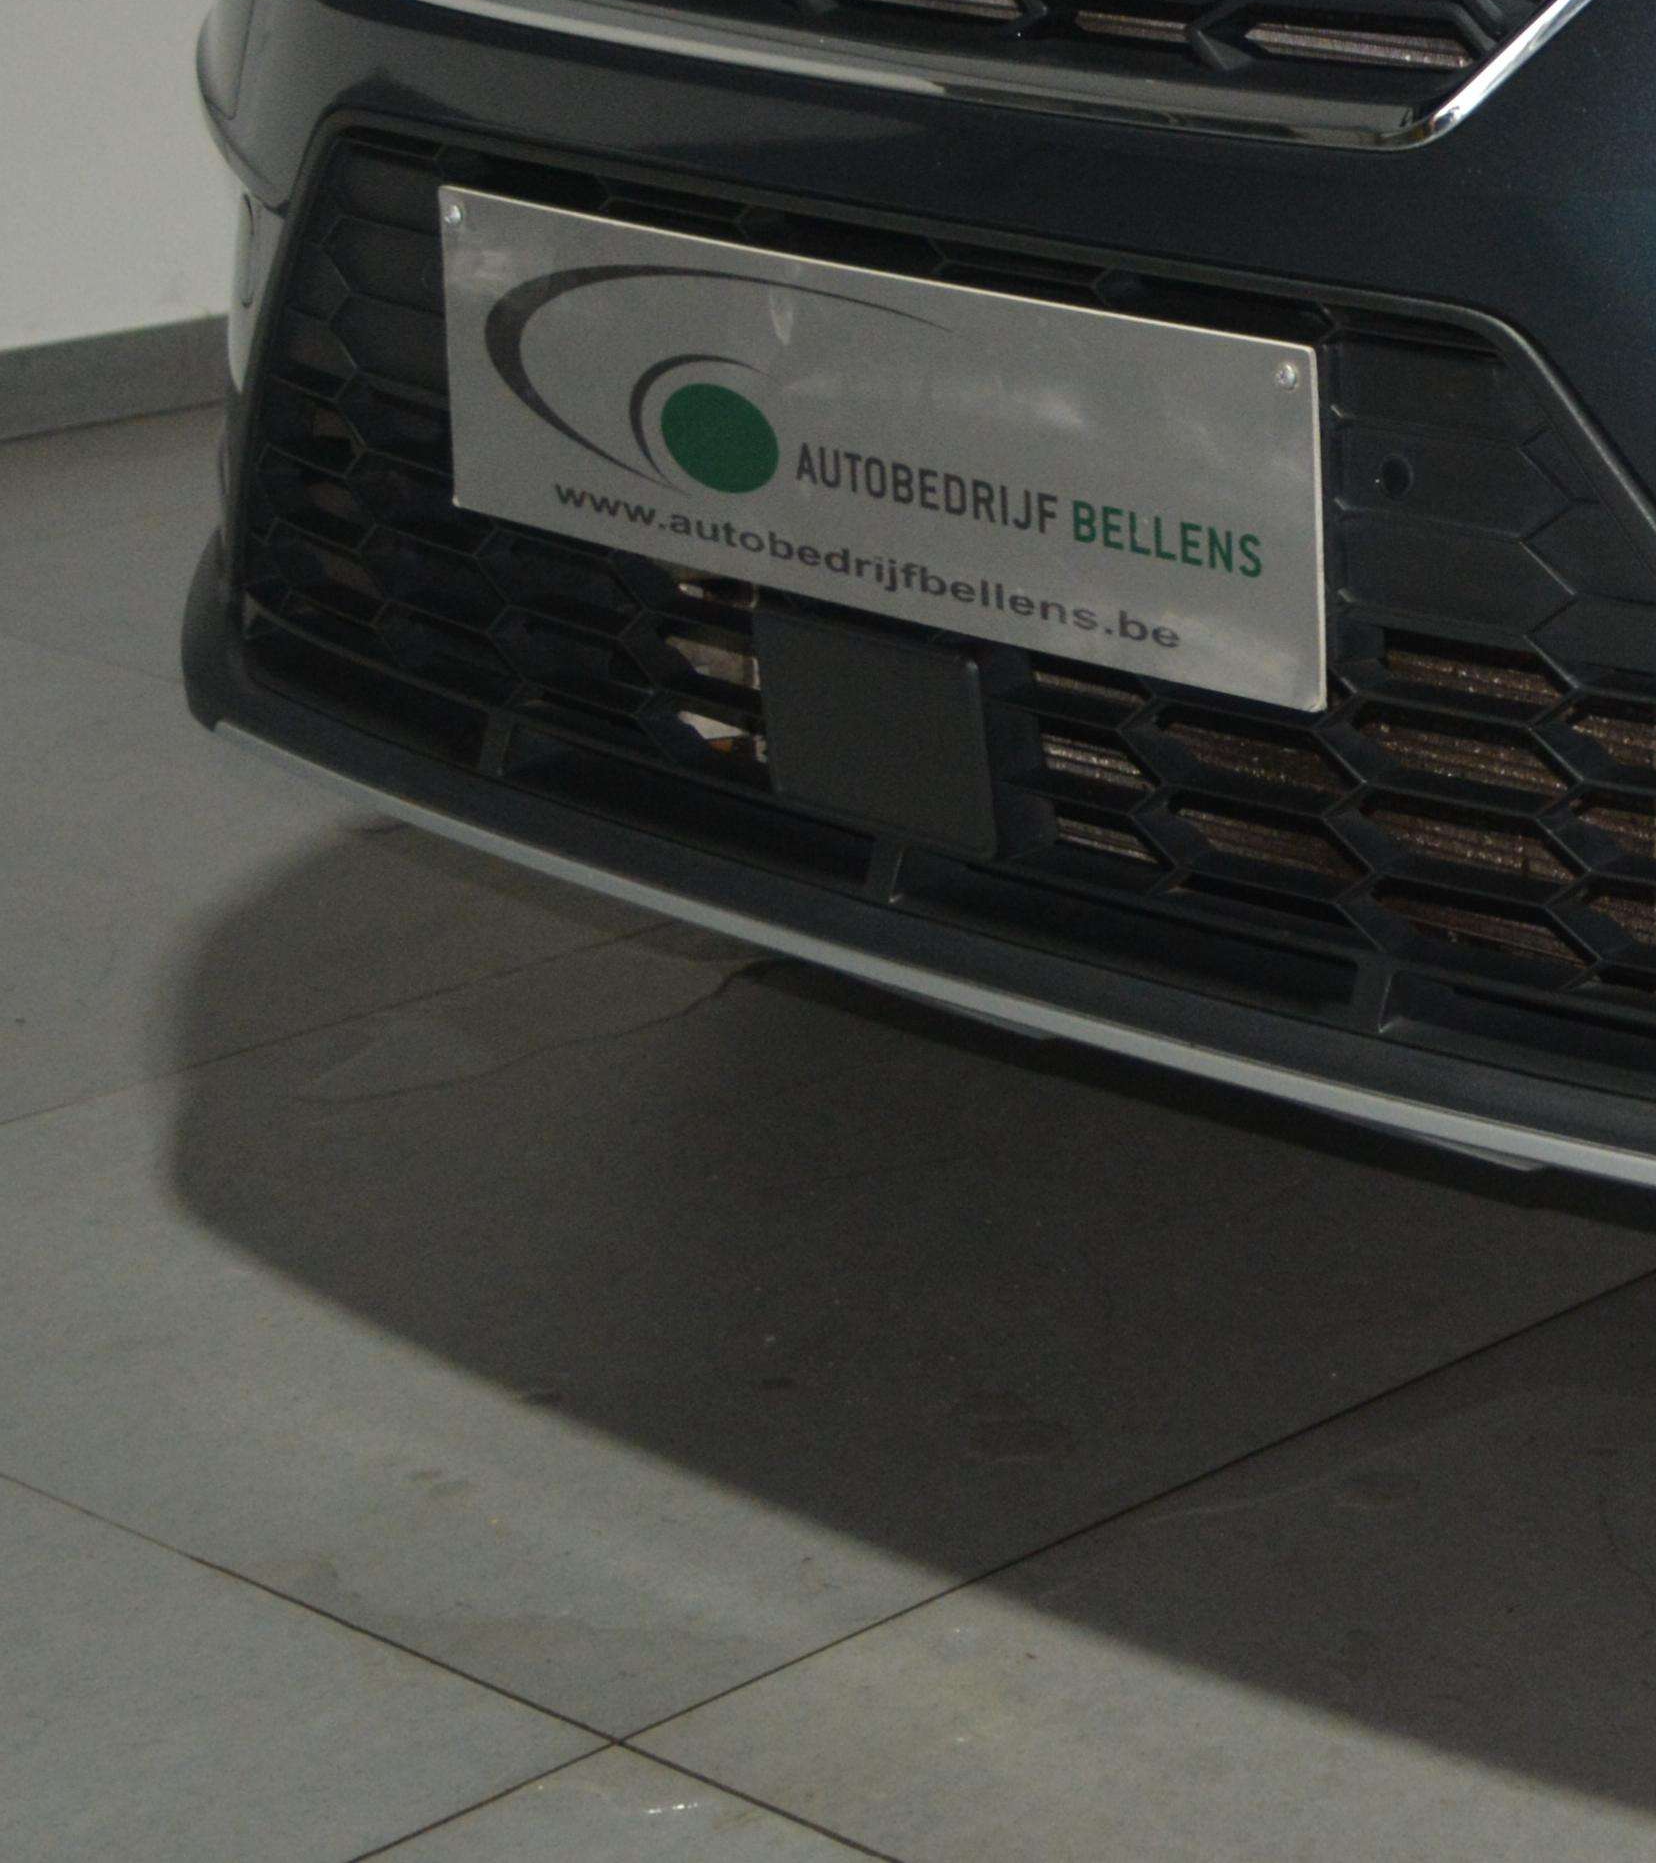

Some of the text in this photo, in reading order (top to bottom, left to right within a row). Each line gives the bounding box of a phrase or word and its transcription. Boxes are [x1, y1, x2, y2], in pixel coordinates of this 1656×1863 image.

[555, 483, 1181, 649] www.autobedrijfbellens.be
[796, 442, 1263, 579] AUTOBEDRIJF BELLENS
